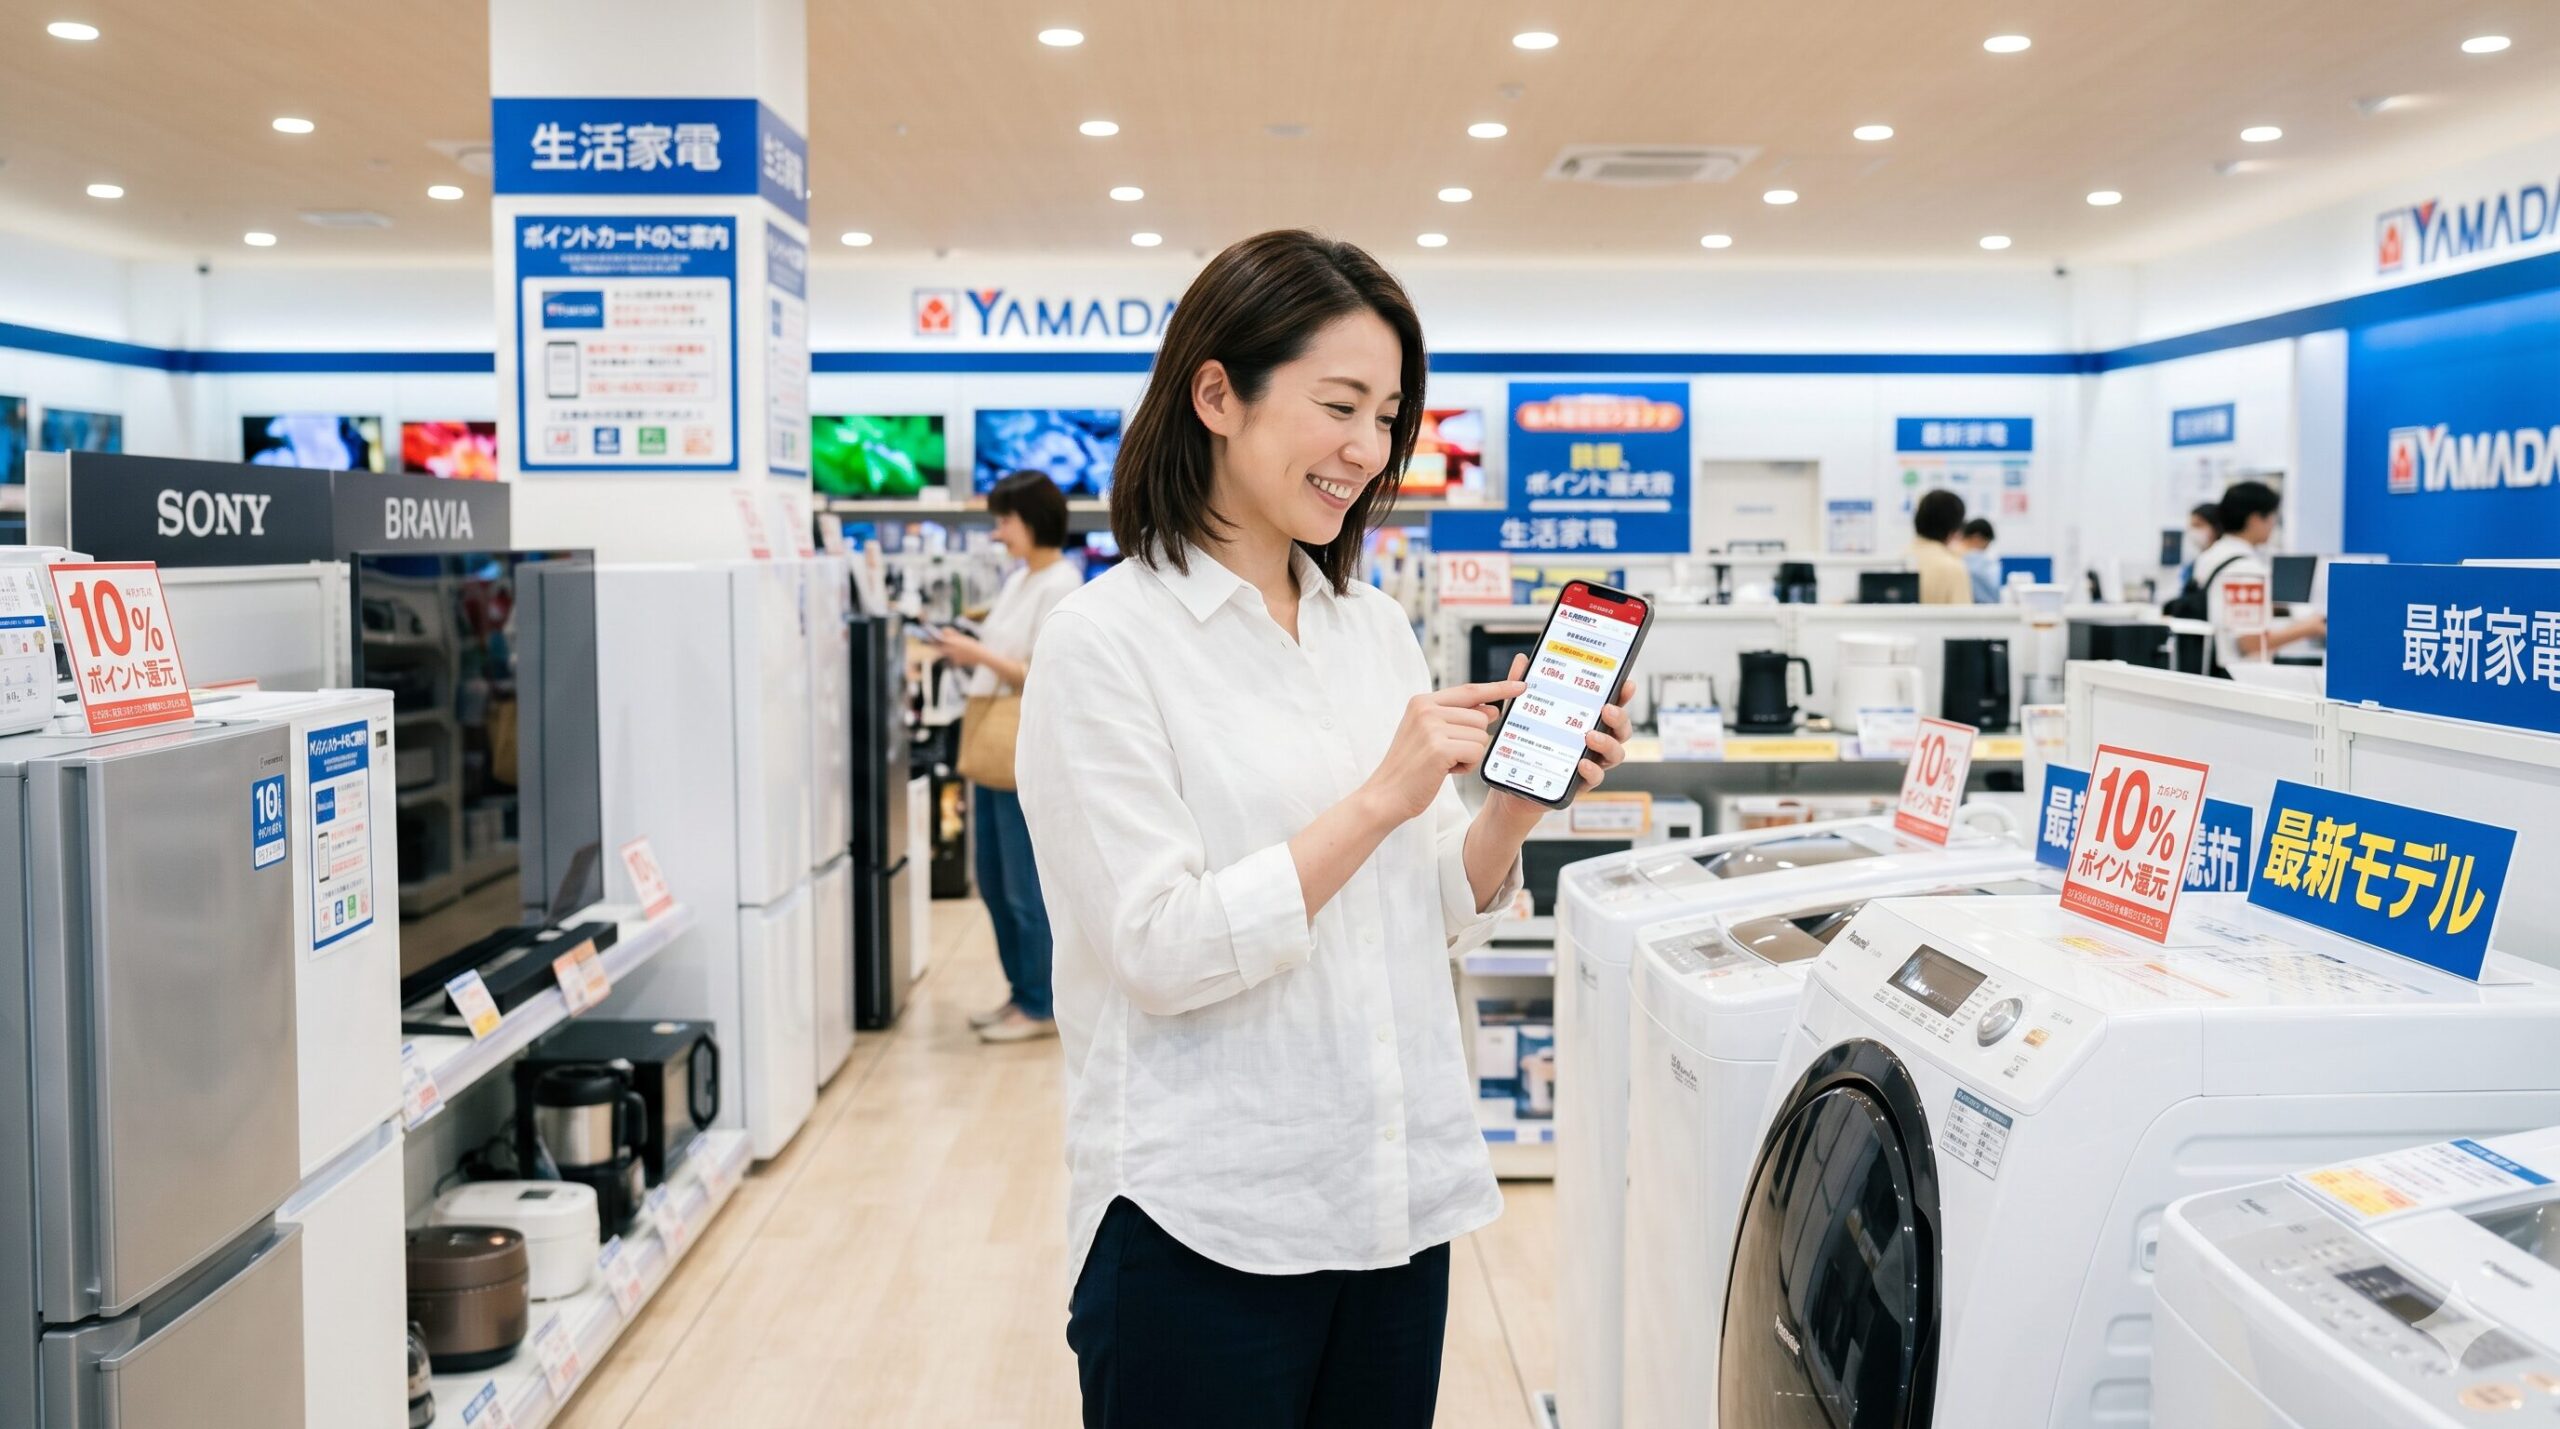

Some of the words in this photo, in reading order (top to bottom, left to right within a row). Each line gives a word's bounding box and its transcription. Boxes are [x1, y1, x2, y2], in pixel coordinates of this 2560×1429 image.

[531, 122, 722, 171] 生活家電
[523, 224, 729, 251] ポイントカードのご案内
[157, 489, 271, 537] SONY
[385, 497, 474, 540] BRAVIA
[1500, 517, 1617, 549] 生活家電
[69, 580, 164, 657] 10%
[2403, 603, 2560, 692] 最新家電
[88, 658, 177, 695] ポイント還元
[2095, 766, 2176, 862] 10%
[2077, 848, 2171, 902] ポイント還元
[2263, 808, 2486, 935] 最新モデル
